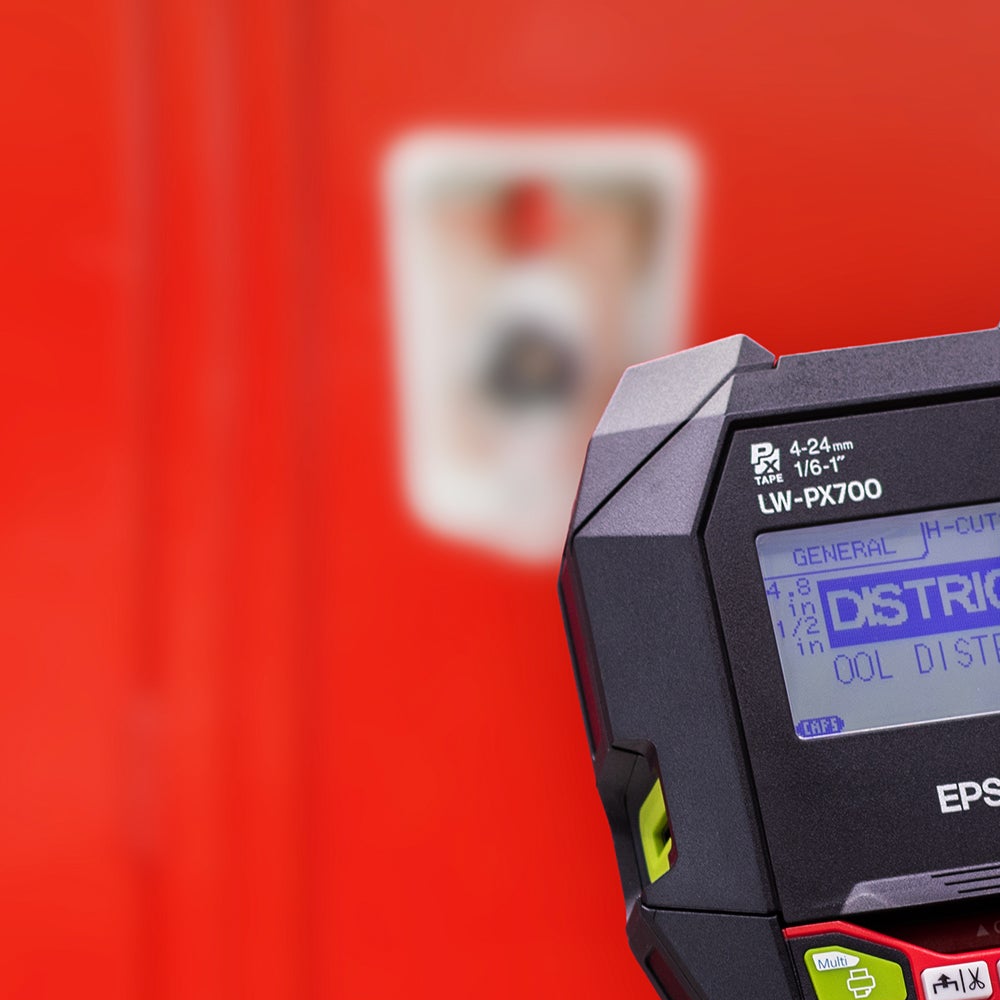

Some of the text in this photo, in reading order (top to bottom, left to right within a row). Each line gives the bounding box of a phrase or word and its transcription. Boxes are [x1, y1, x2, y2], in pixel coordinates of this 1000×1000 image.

[754, 473, 784, 486] TAPE
[757, 478, 882, 514] LW-PX700
[793, 537, 897, 566] GENERAL
[766, 577, 811, 600] 4.8
[788, 599, 816, 617] in
[777, 616, 820, 639] 1/2
[797, 637, 824, 656] in
[833, 650, 894, 685] OOL
[802, 717, 840, 737] CAPS
[818, 955, 848, 970] Multi
